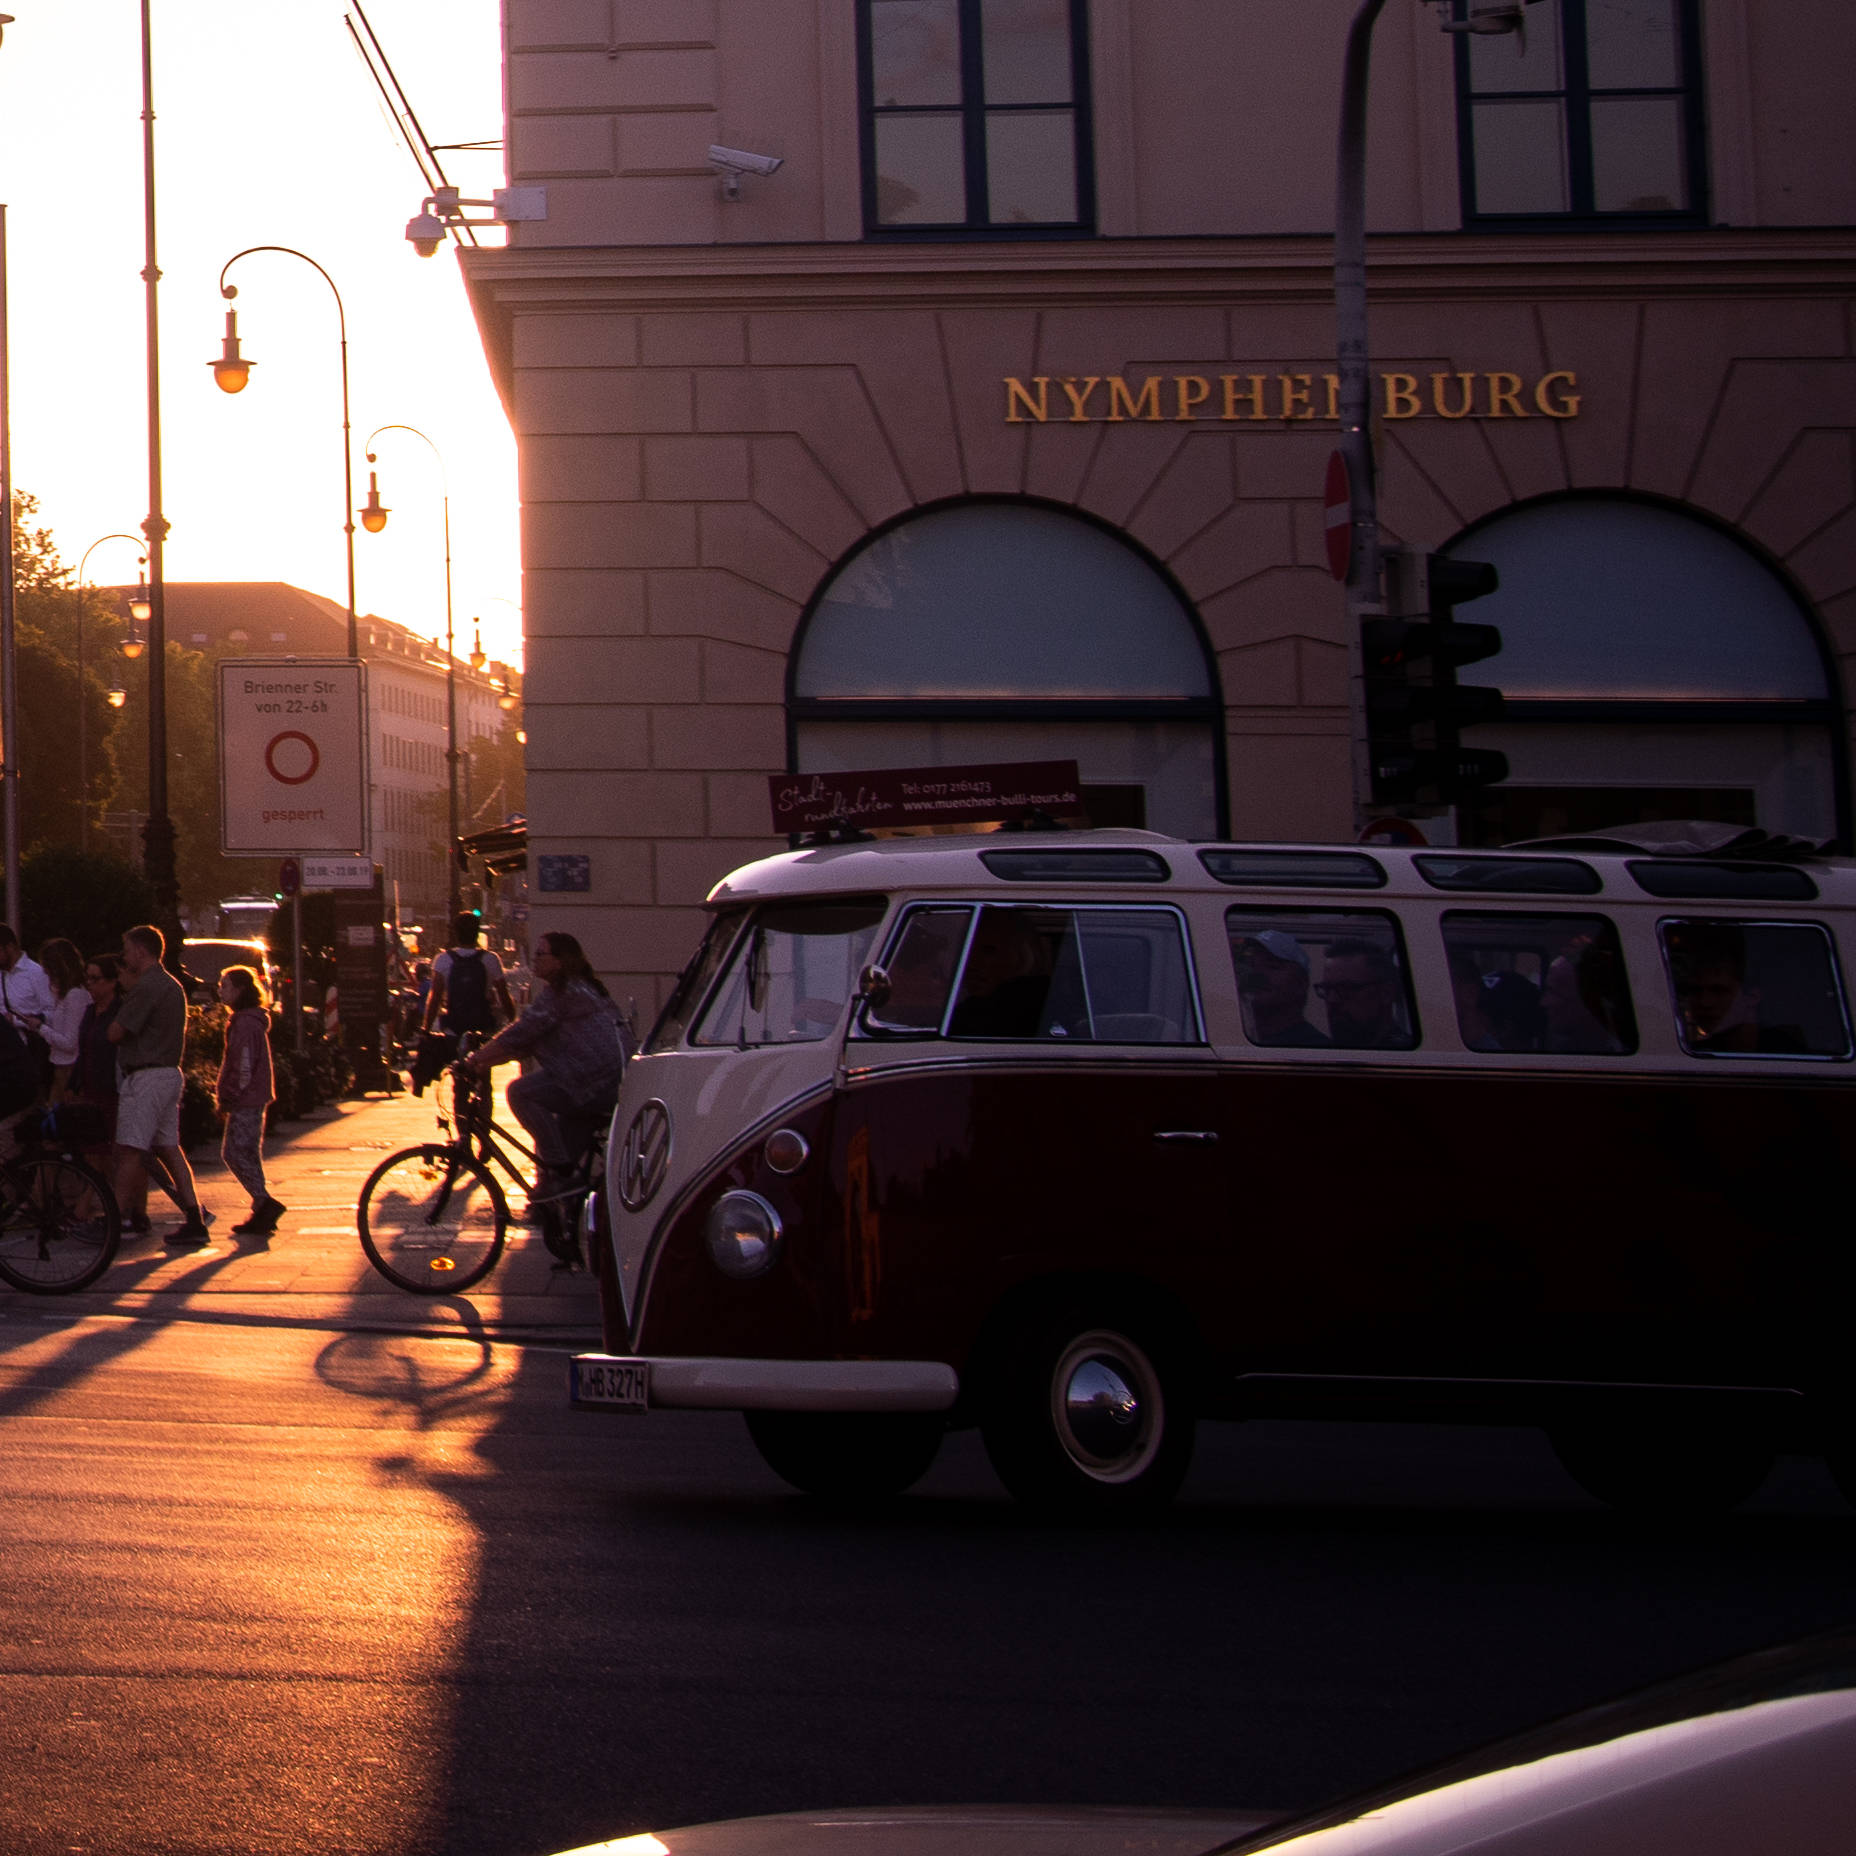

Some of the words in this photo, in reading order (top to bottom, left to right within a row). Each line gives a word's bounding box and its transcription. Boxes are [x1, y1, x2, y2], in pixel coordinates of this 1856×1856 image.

[244, 680, 309, 694] Brienner
[314, 680, 338, 694] Str.
[255, 702, 281, 713] von
[286, 700, 327, 713] 22-6h
[778, 775, 833, 812] Stadt-
[903, 791, 1079, 812] www.muenchner-bulli-tours.de
[262, 809, 325, 824] gesperrt
[607, 1368, 645, 1399] 327H
